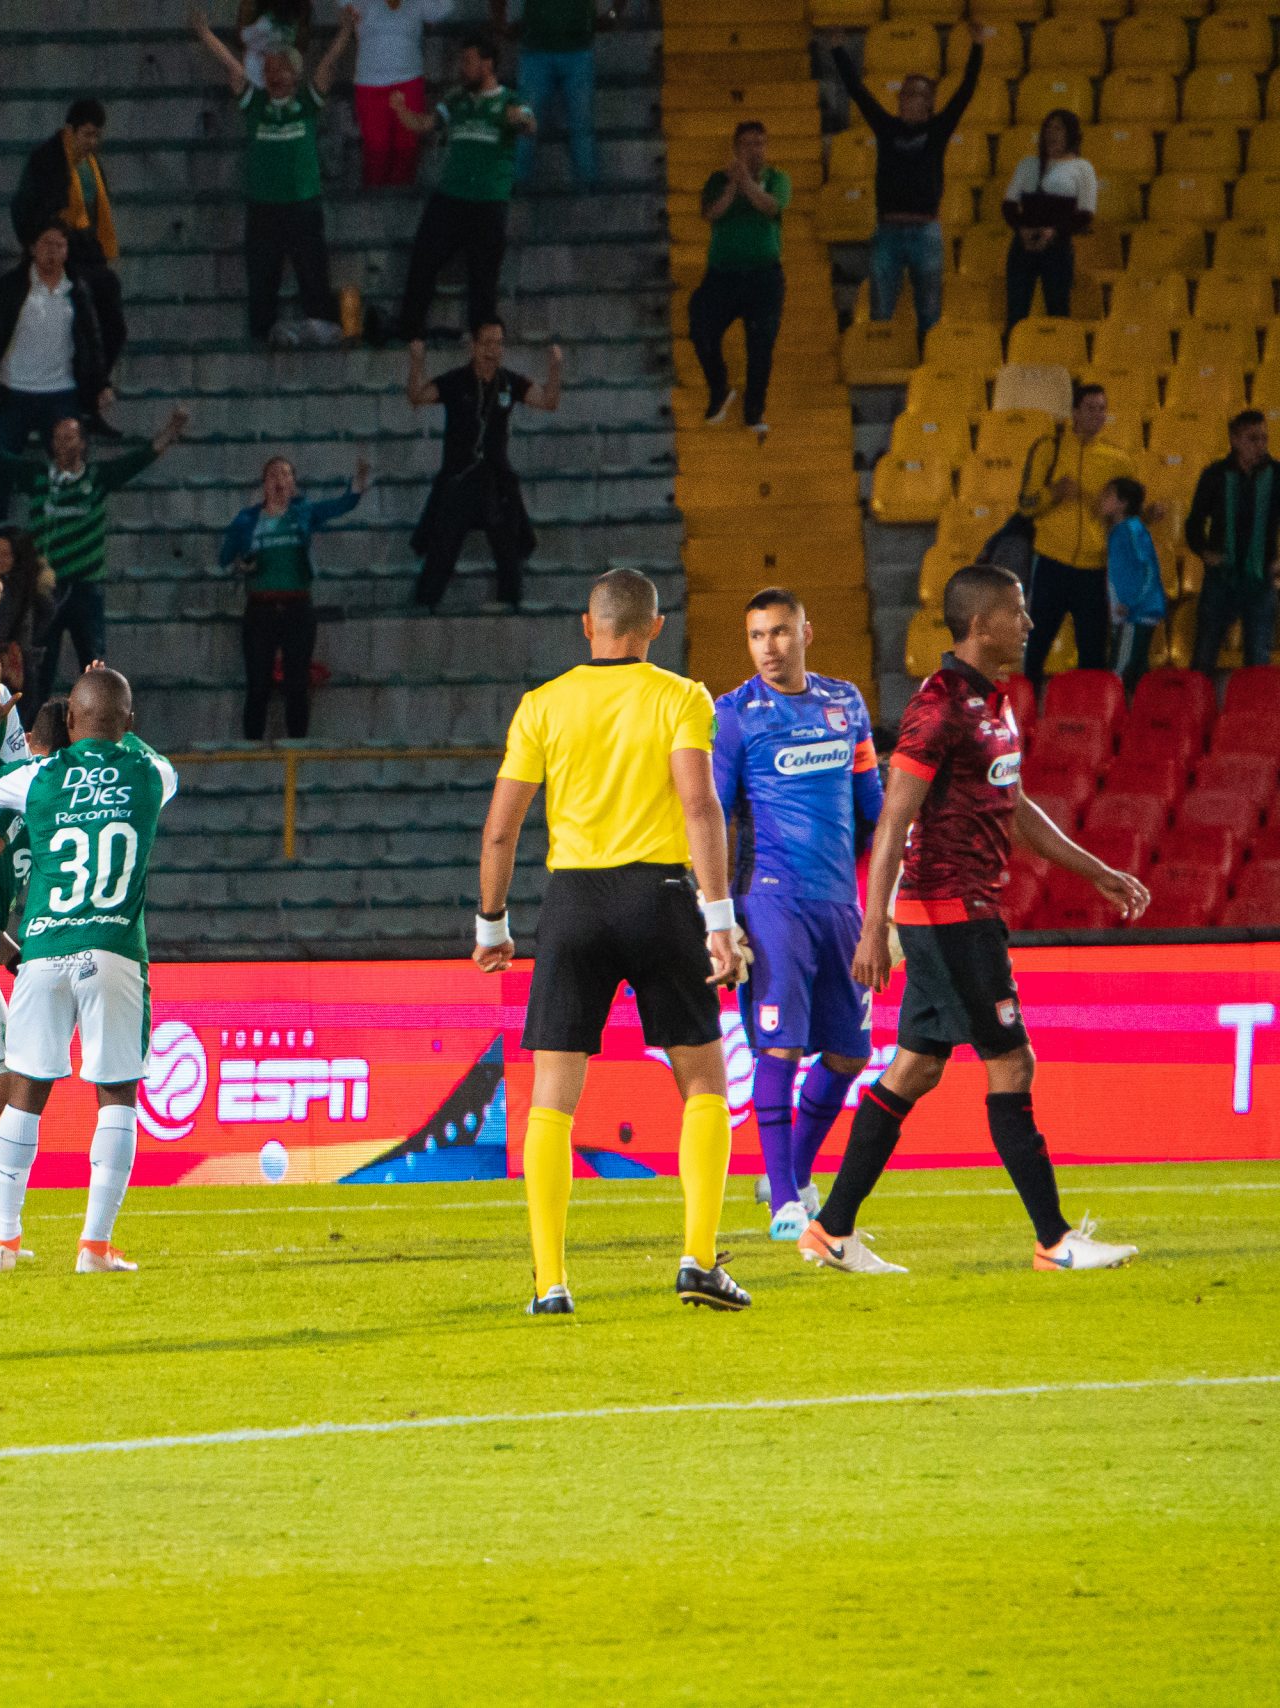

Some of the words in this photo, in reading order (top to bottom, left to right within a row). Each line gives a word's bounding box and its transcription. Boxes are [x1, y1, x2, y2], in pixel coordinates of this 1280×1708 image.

[778, 748, 849, 768] Colanta
[49, 821, 138, 913] 30
[218, 1058, 370, 1122] ESPN
